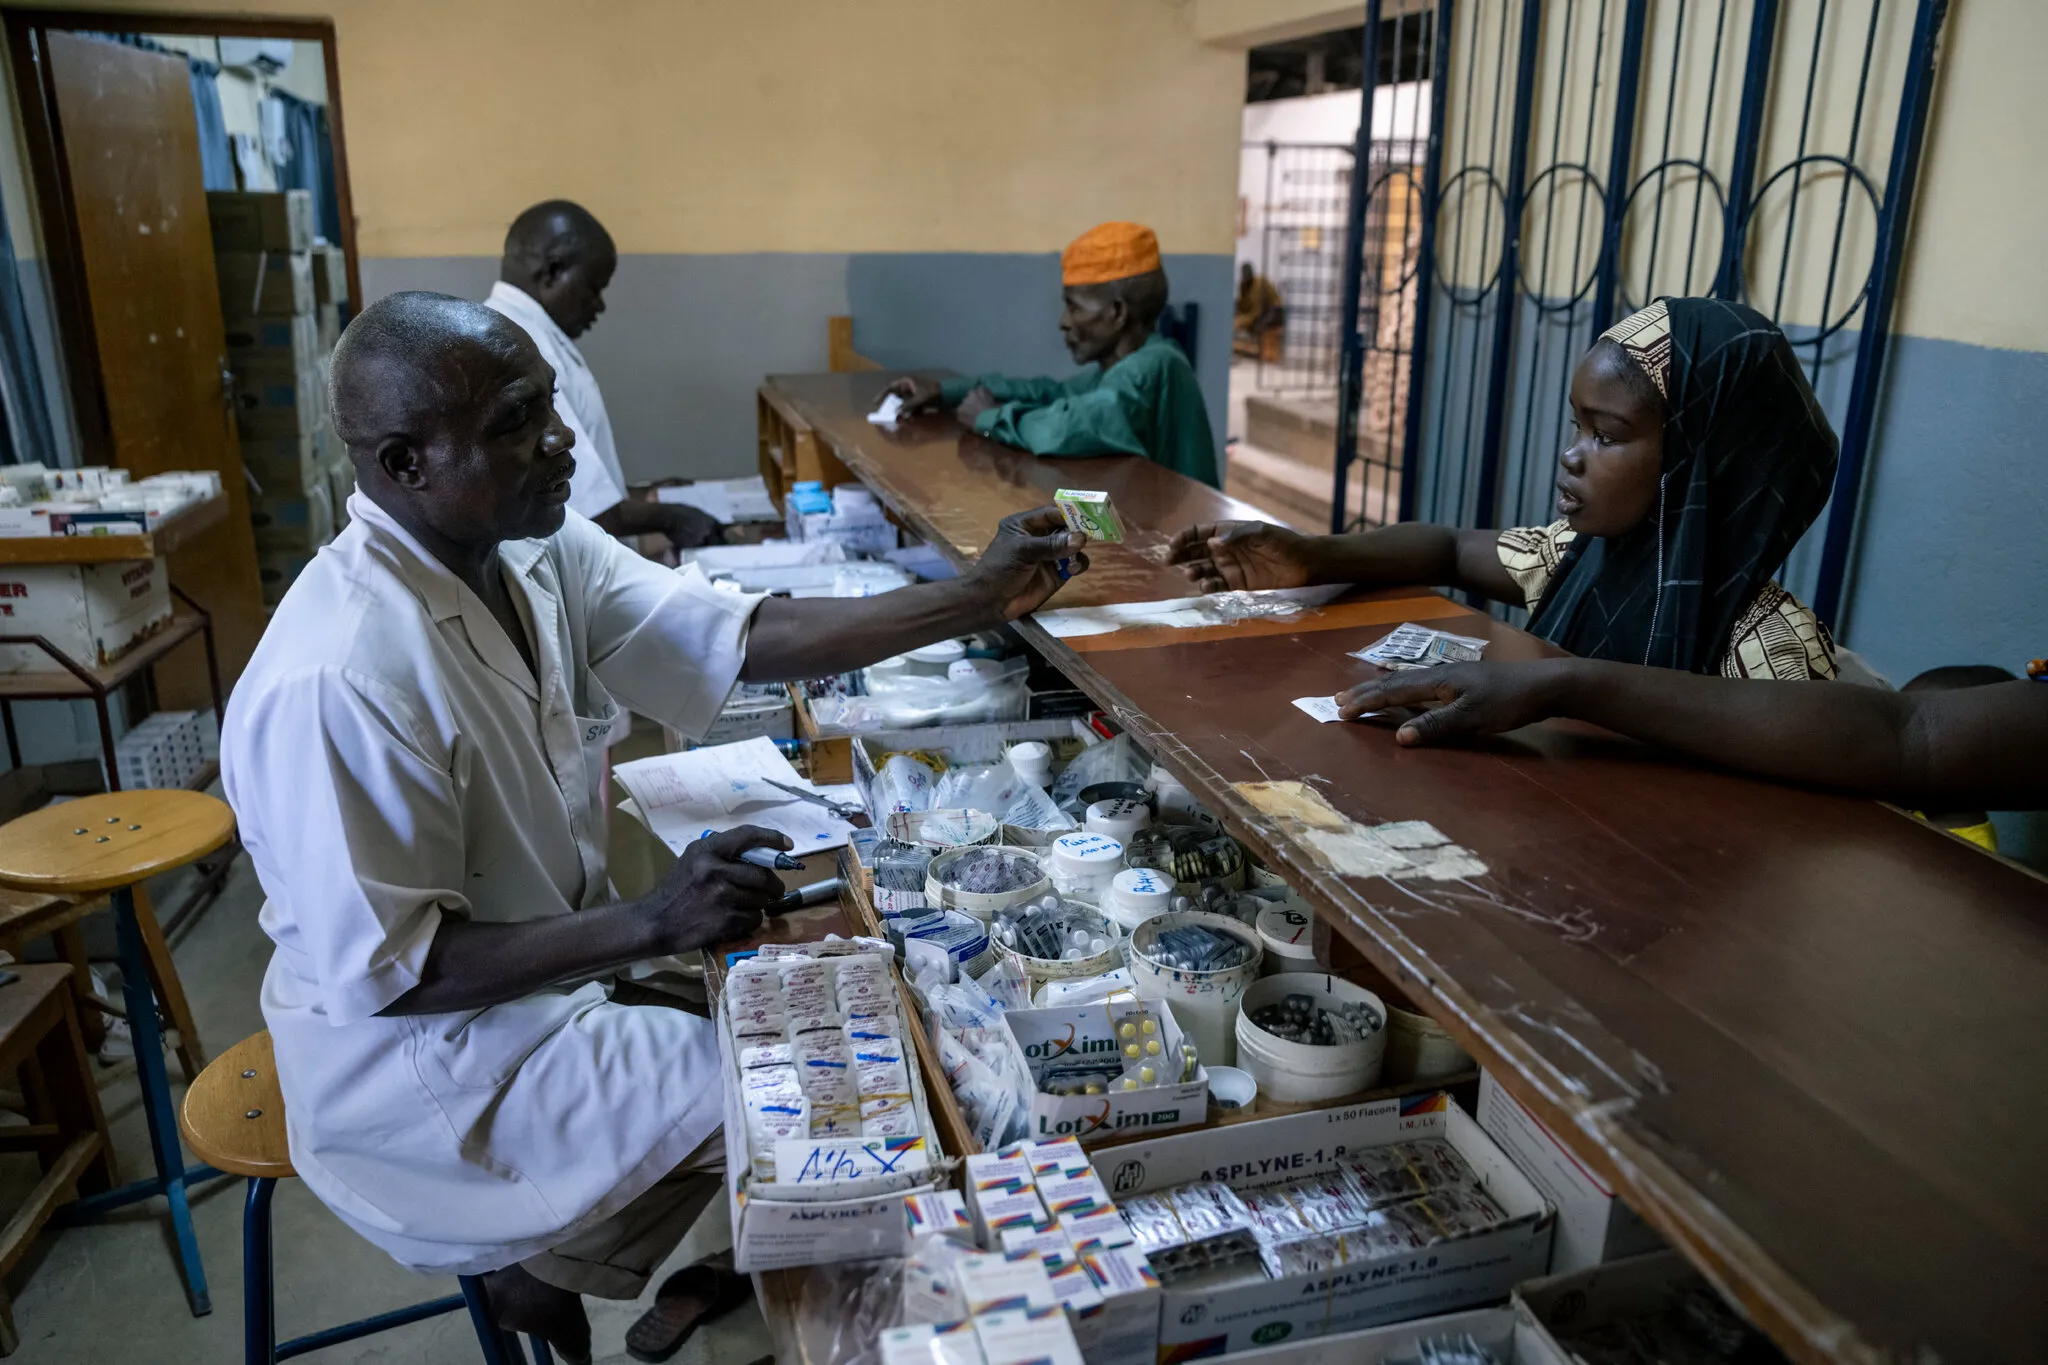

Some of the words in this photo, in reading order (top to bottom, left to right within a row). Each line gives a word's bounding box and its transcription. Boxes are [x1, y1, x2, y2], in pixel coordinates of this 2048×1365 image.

[1024, 1022, 1114, 1061] otXim
[1343, 1110, 1357, 1120] 50
[1358, 1104, 1398, 1118] Flacons
[1201, 1145, 1347, 1182] ASPLYNE-1.8
[1302, 1256, 1439, 1294] ASPLYNE-1.8
